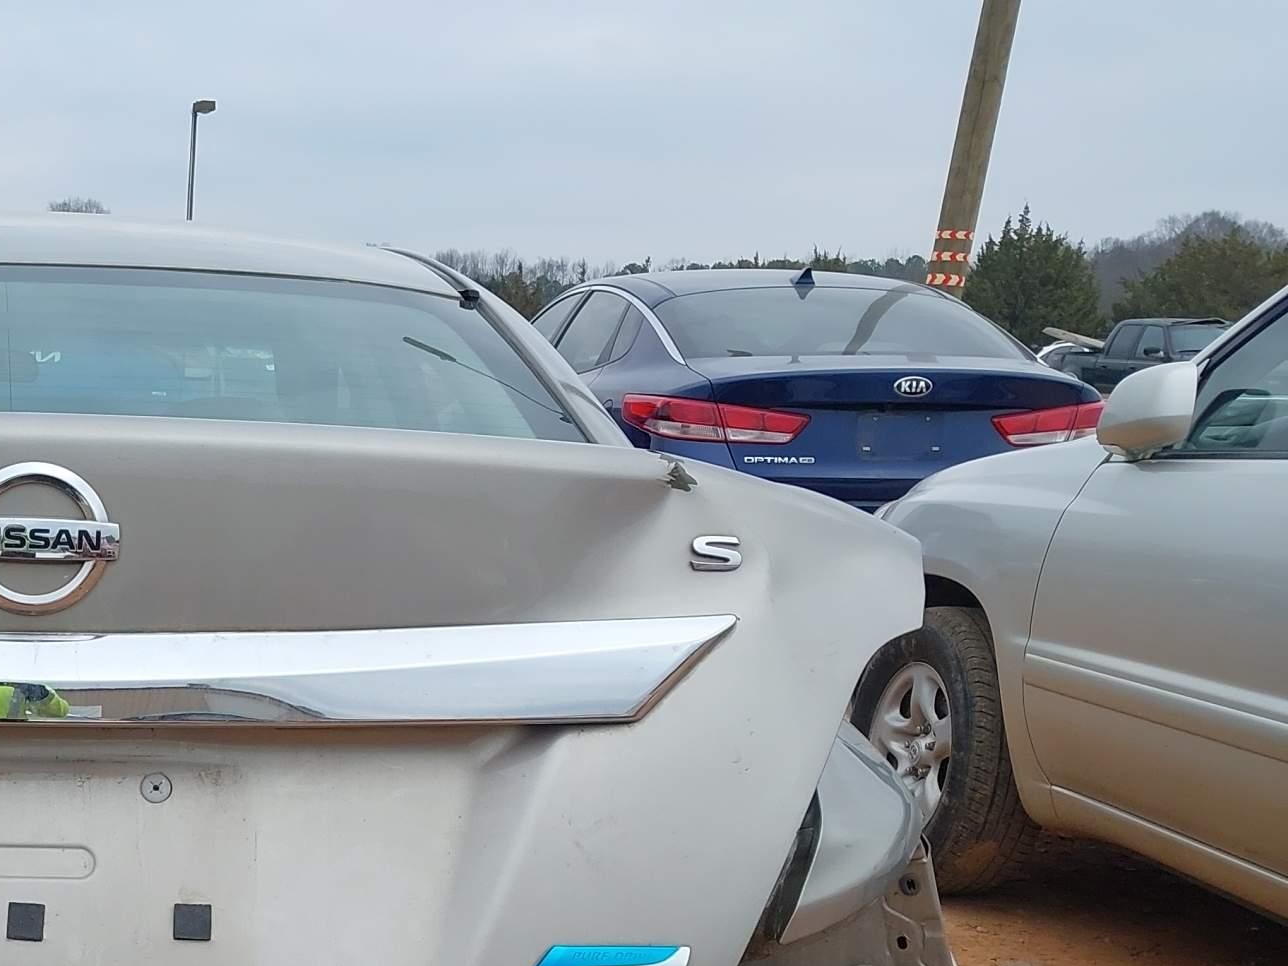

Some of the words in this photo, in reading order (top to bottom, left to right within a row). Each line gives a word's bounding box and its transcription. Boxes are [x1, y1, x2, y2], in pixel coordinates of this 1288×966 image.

[900, 380, 927, 393] KIA
[743, 456, 799, 464] OPTIMA
[690, 535, 742, 572] S
